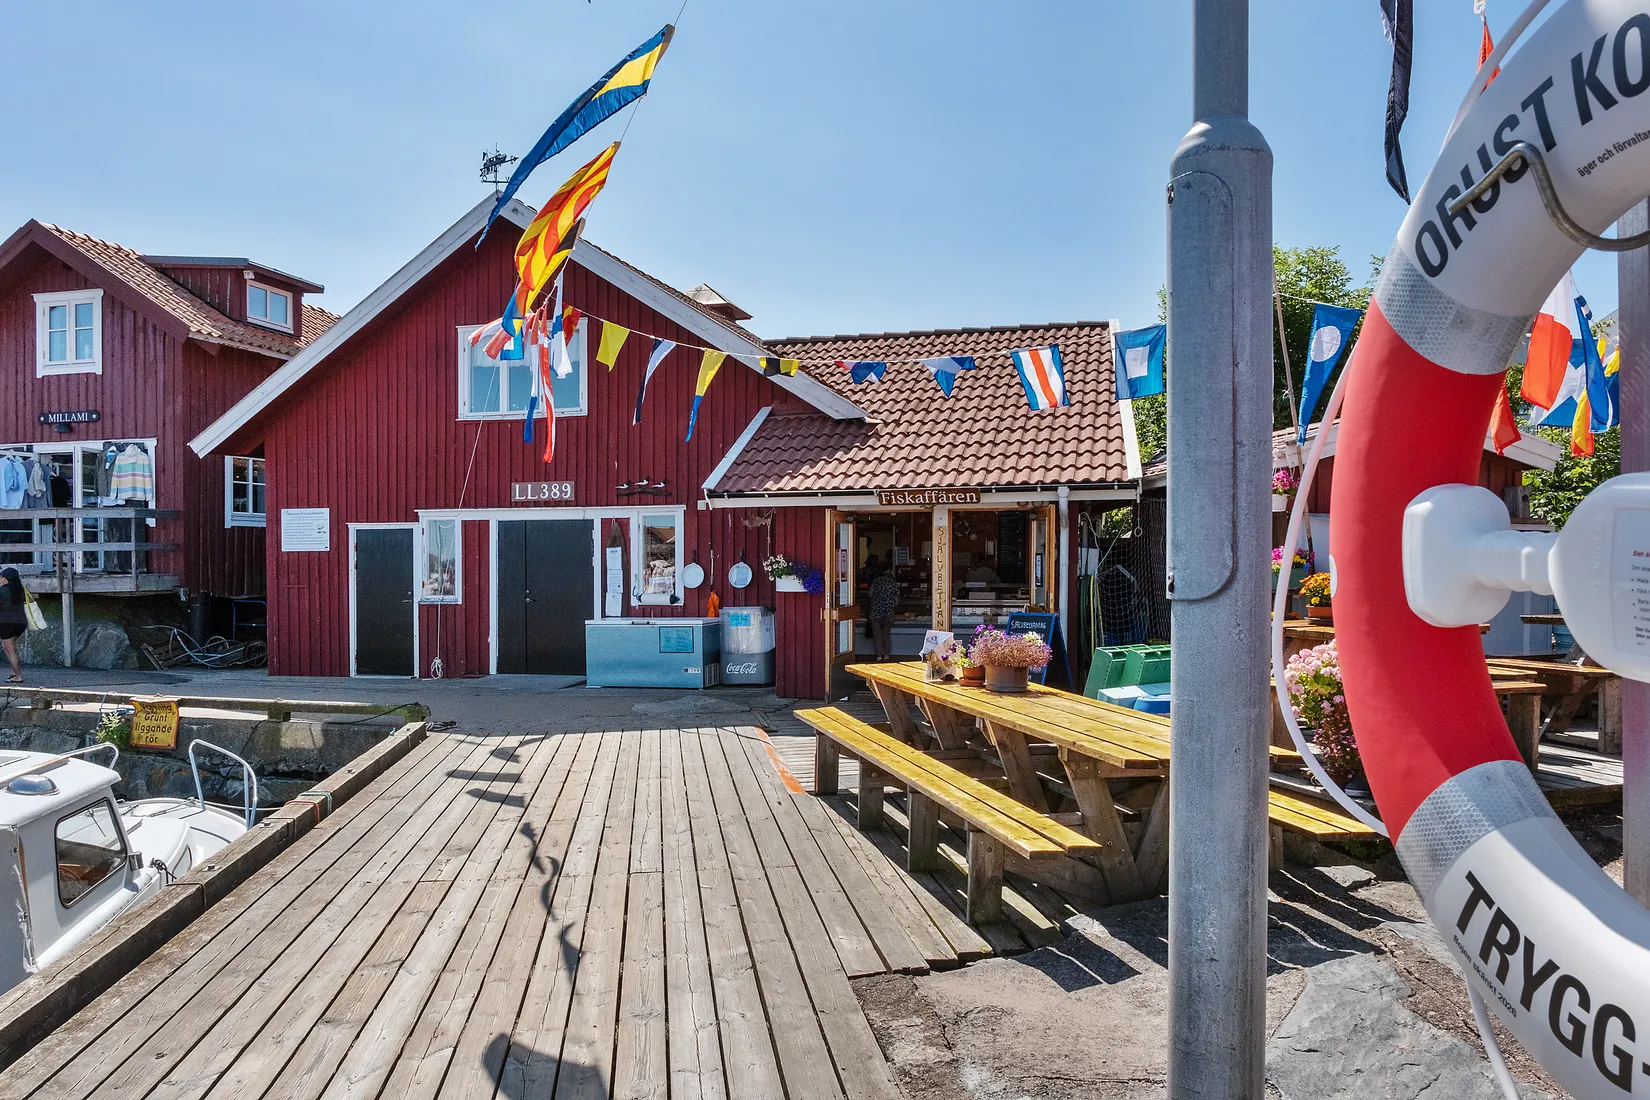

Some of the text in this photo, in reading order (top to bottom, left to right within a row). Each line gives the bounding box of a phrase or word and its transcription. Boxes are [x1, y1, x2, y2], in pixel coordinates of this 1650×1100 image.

[1576, 160, 1598, 177] äger
[1597, 148, 1615, 164] och
[1415, 76, 1557, 278] ORUST
[48, 412, 88, 423] MILLAMI
[515, 483, 571, 500] LL389
[880, 490, 978, 504] Fiskaffären
[144, 712, 167, 722] Grunt
[135, 722, 172, 734] liggande
[145, 734, 158, 743] rör
[1453, 934, 1517, 1018] Bojen skänkt 2026
